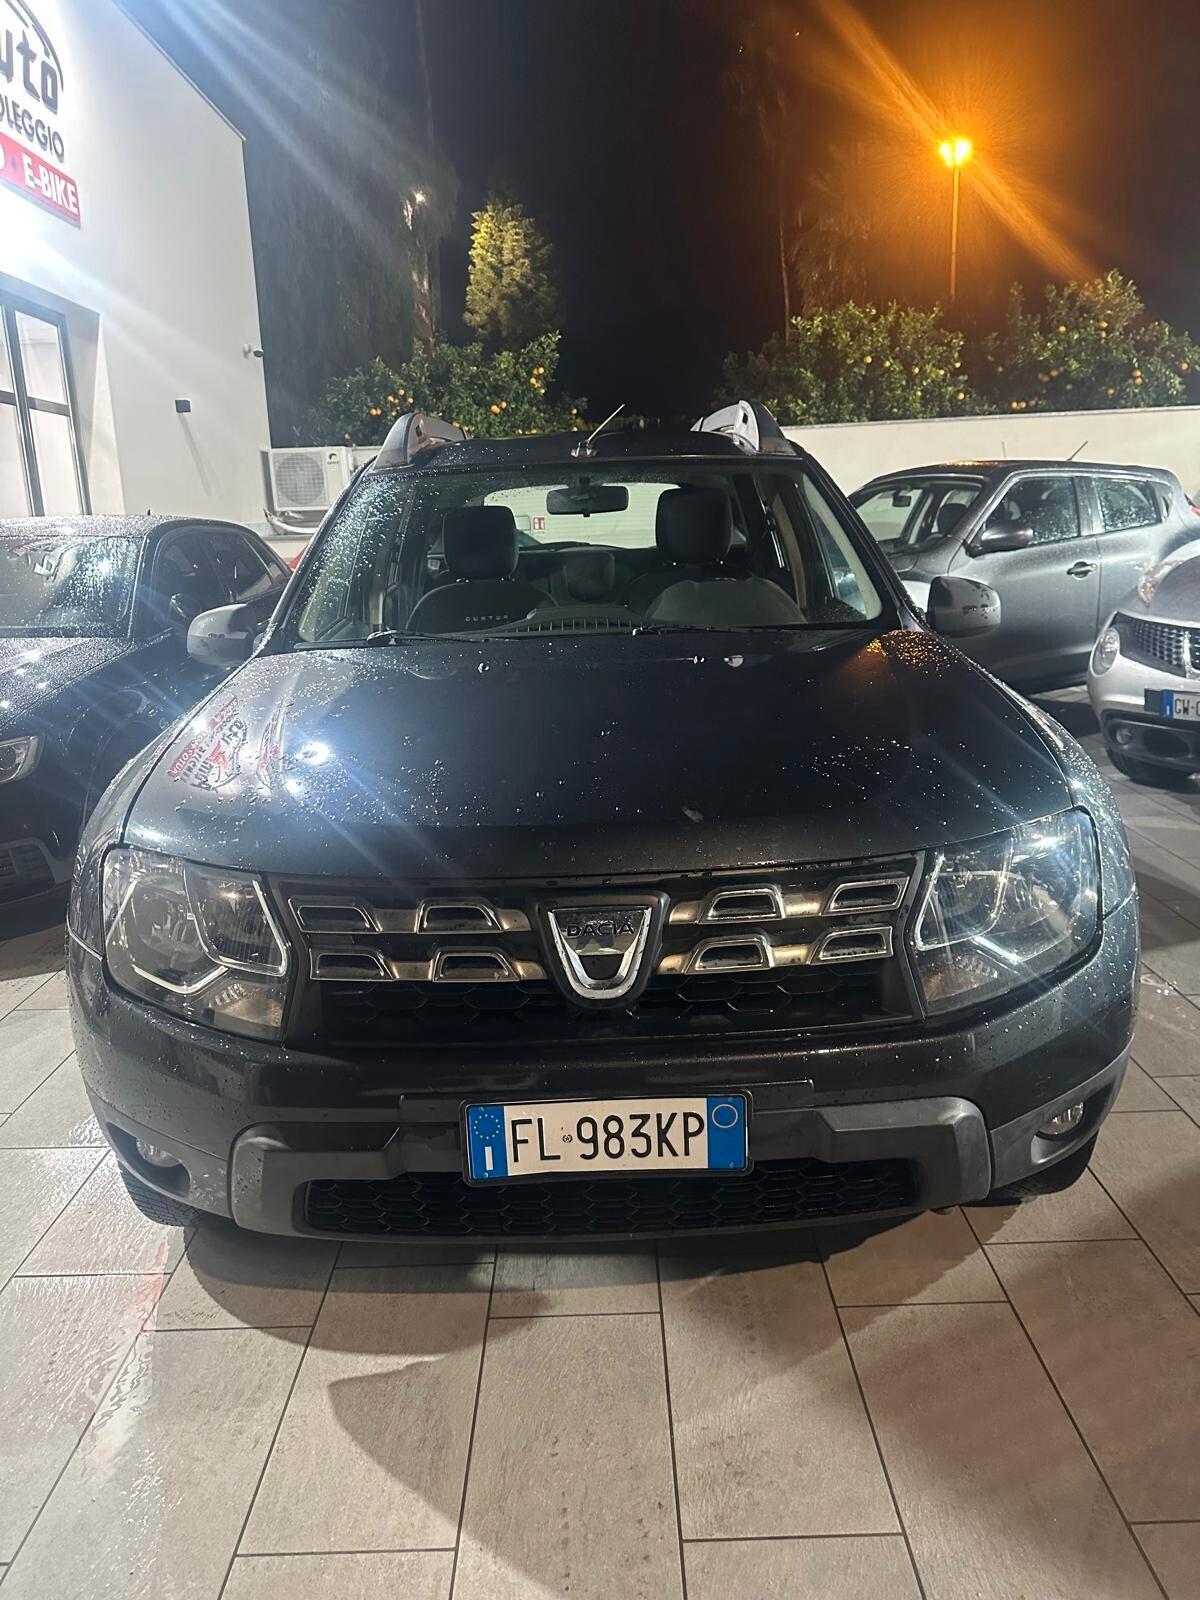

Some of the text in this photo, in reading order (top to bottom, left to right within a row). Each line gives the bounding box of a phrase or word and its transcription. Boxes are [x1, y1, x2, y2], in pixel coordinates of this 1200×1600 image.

[22, 152, 79, 216] E-BIKE
[567, 922, 635, 937] DACIA
[510, 1111, 706, 1163] FL 983KP
